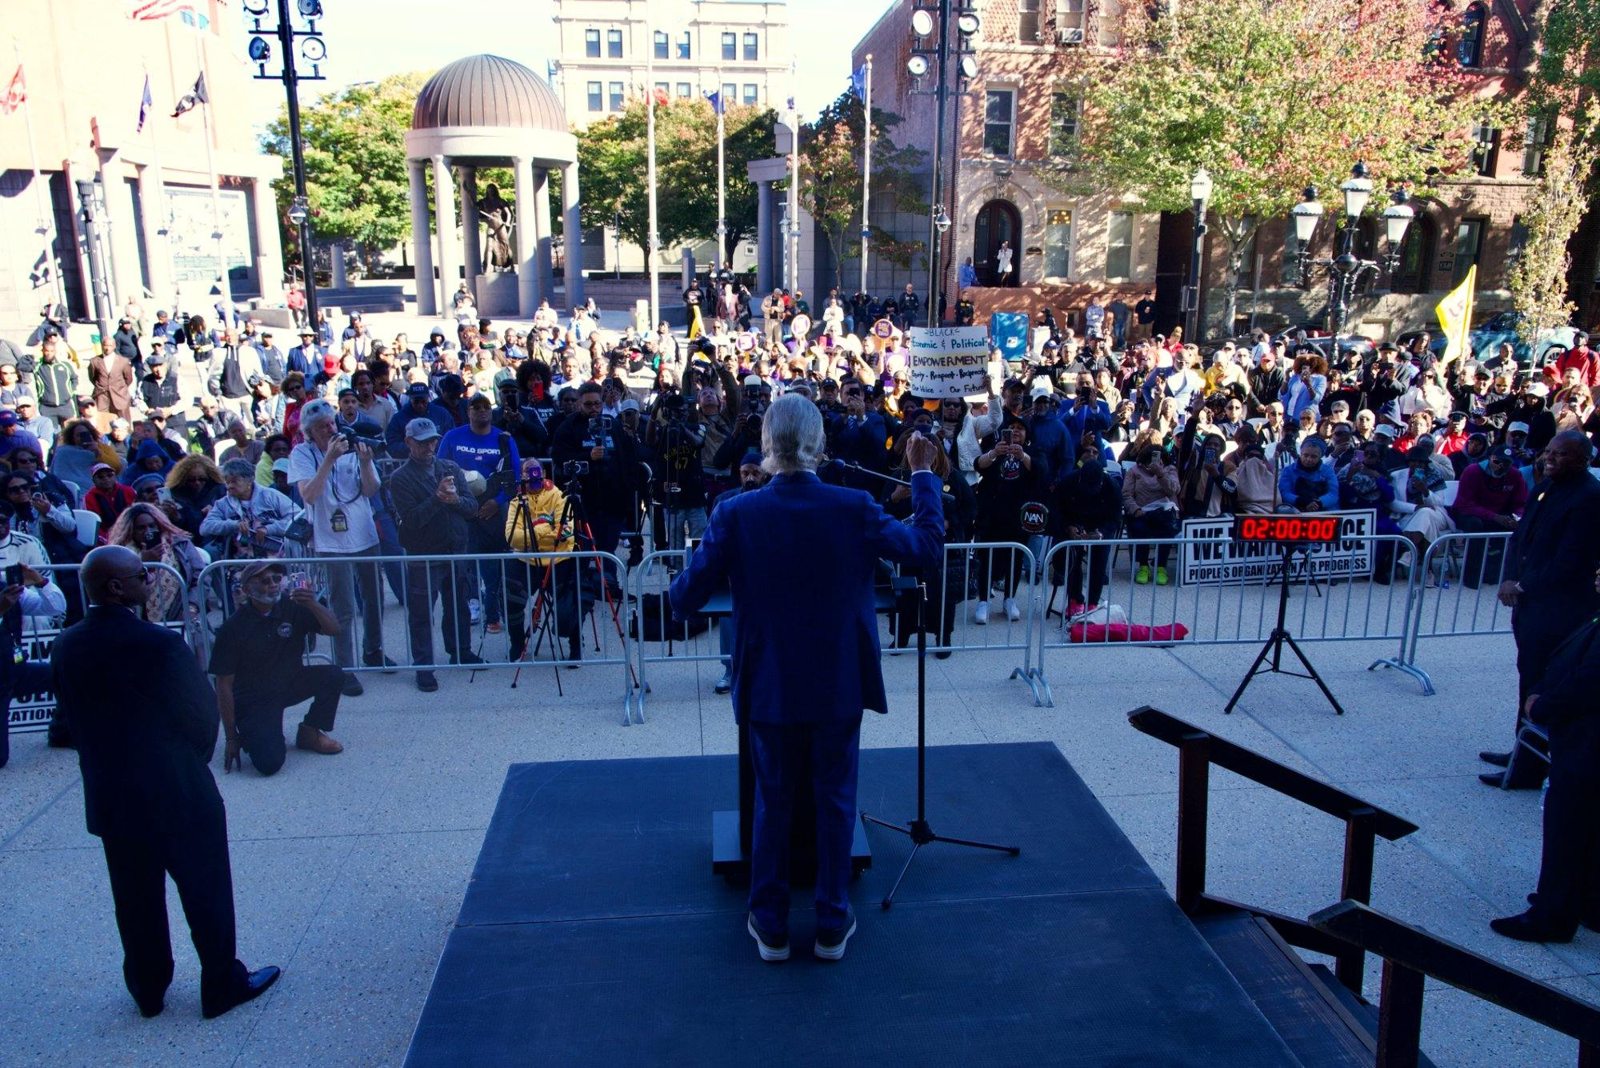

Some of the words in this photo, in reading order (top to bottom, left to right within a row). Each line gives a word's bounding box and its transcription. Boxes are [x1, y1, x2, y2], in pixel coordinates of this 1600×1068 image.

[912, 355, 986, 367] EMPOWERMENT
[456, 445, 476, 454] POLO
[1024, 511, 1044, 523] NAN
[1241, 518, 1335, 540] 02:00:00
[1192, 527, 1223, 560] WE
[1319, 558, 1367, 572] PROGRSS
